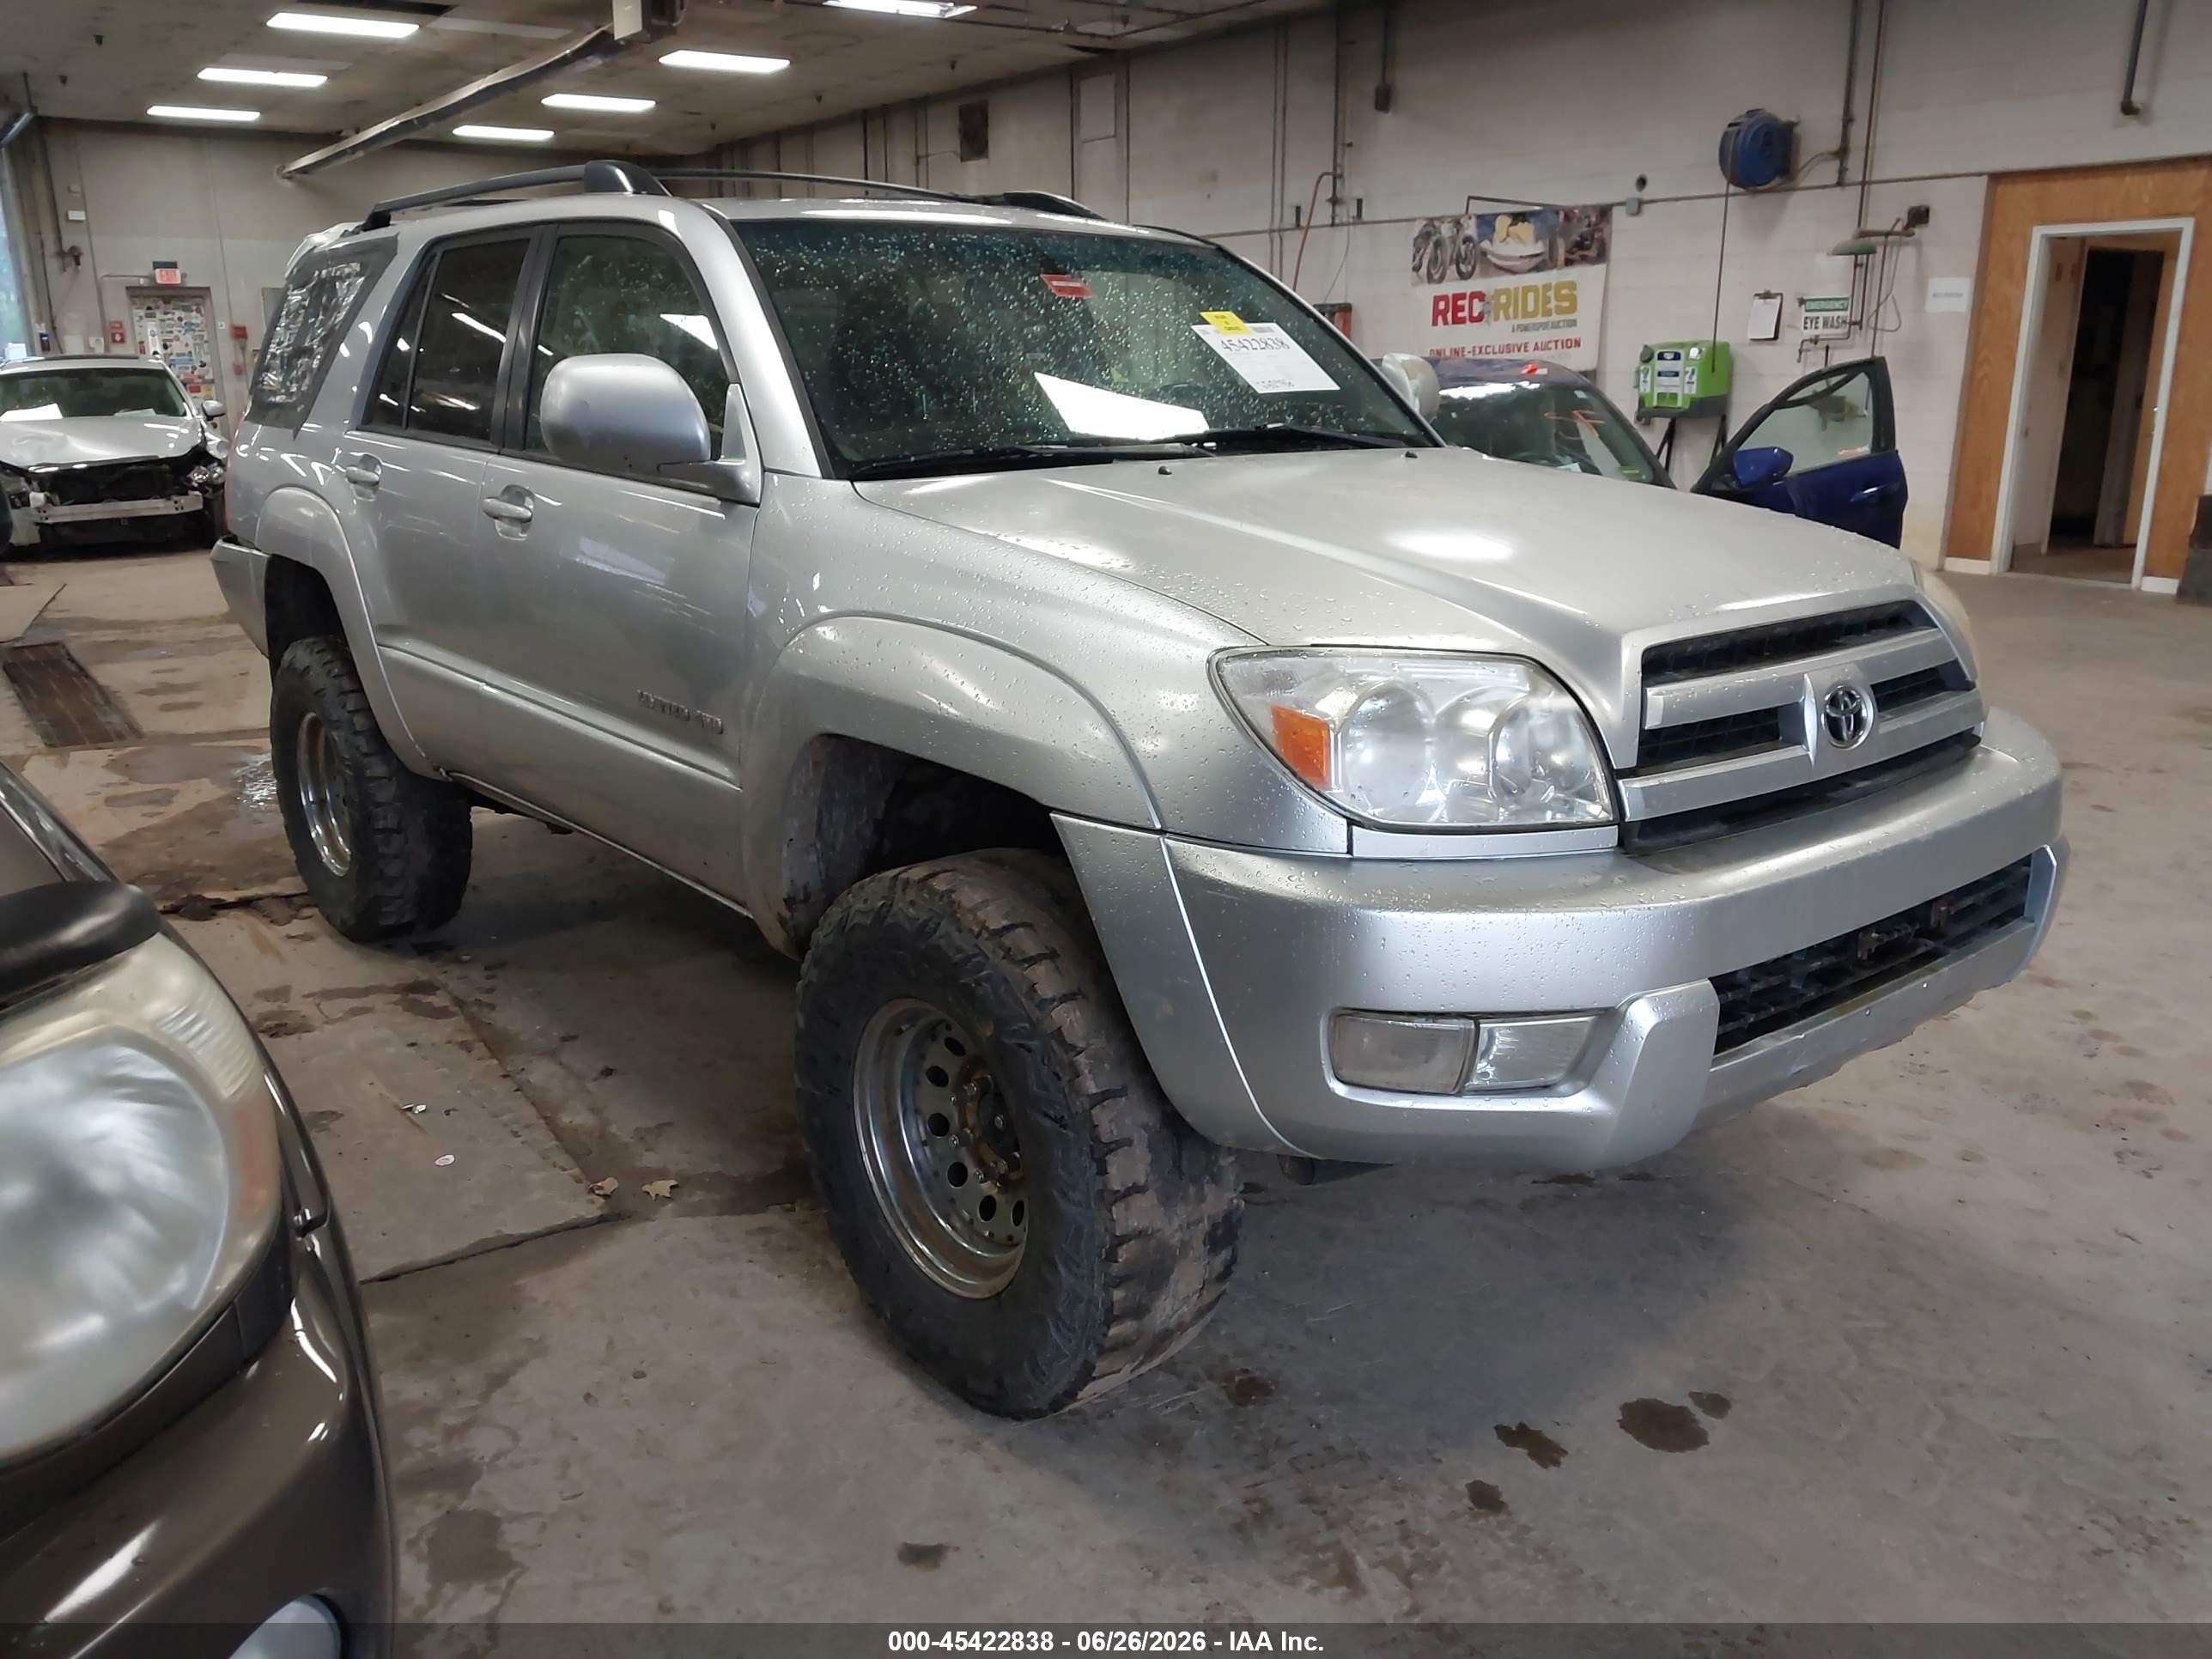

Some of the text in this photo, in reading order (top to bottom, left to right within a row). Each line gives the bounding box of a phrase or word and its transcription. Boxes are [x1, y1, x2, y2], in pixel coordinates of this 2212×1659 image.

[1431, 280, 1578, 326] REC RIDES
[1803, 315, 1848, 331] EYE WASH
[1219, 337, 1291, 352] 45422838
[1429, 337, 1582, 358] ONLINE-EXCLUSIVE AUCTION
